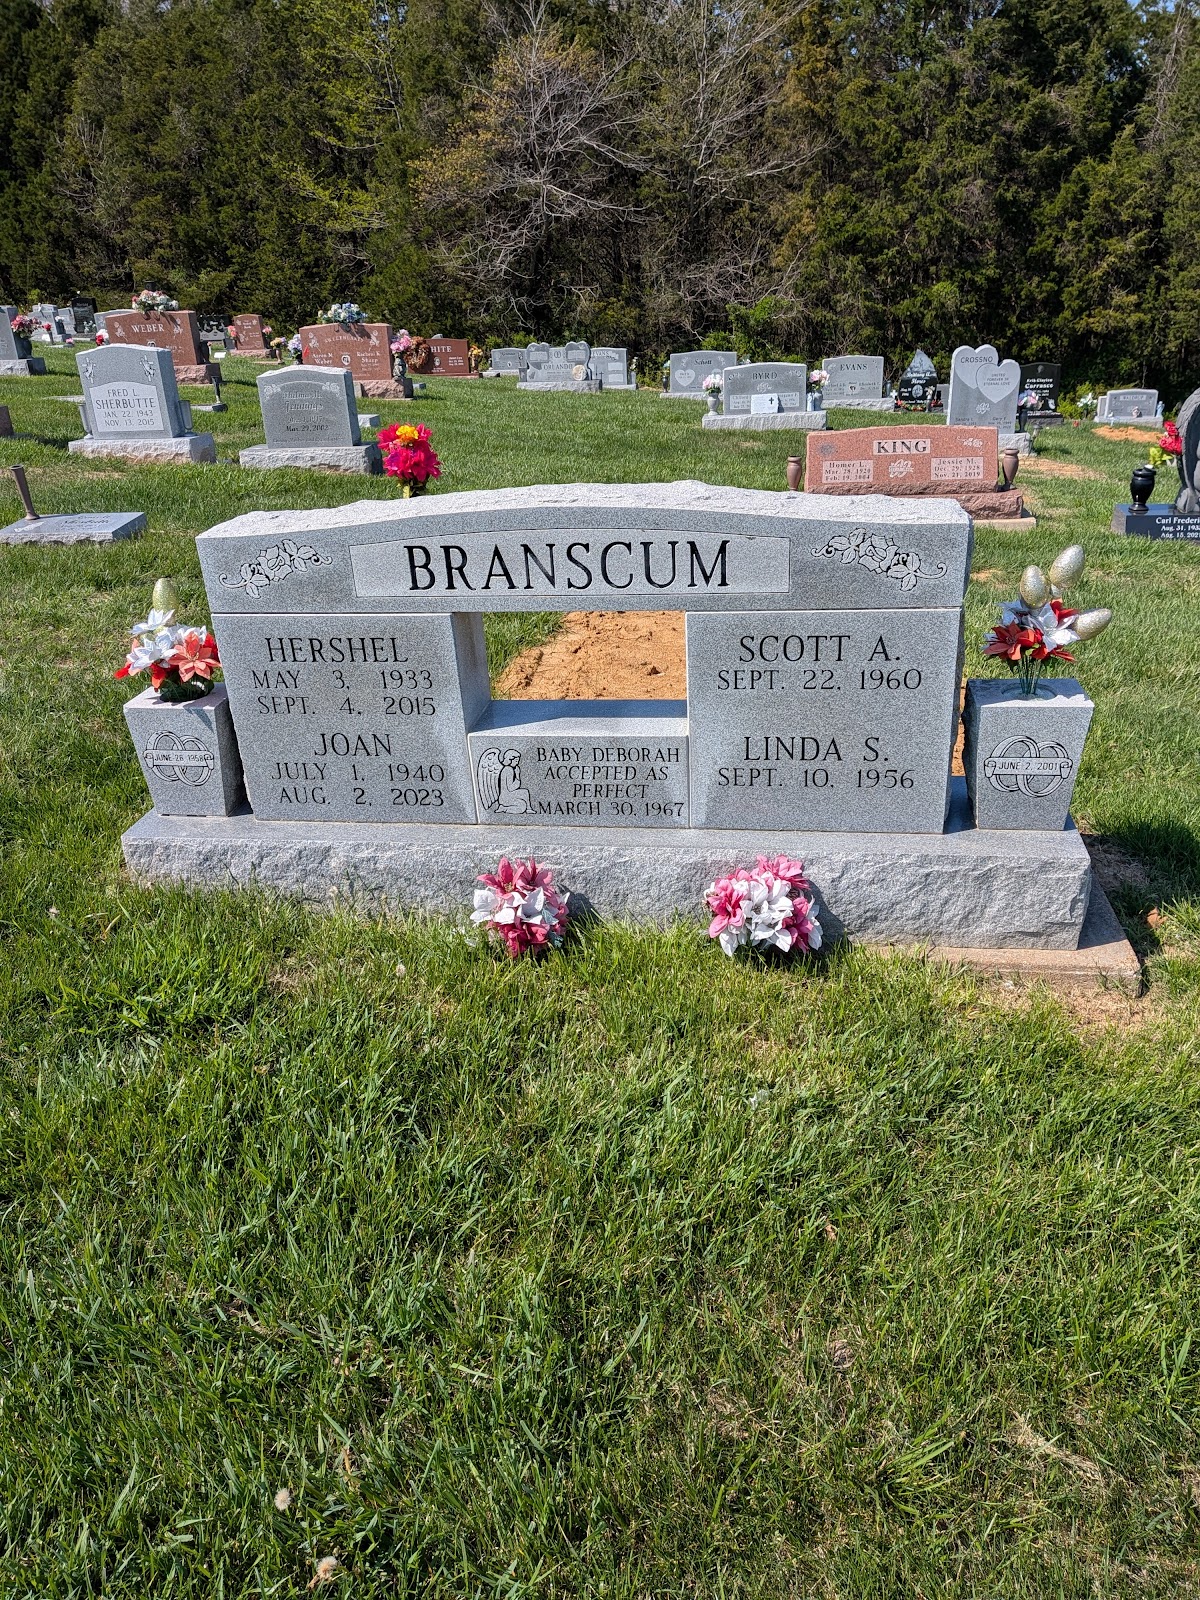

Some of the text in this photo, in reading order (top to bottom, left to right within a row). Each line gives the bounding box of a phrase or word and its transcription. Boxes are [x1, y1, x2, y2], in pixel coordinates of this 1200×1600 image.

[131, 323, 165, 333] WEBER
[430, 345, 452, 353] HITE
[840, 363, 868, 371] EVANS
[960, 356, 994, 364] CROSSNO
[752, 372, 778, 380] BYRD
[107, 388, 129, 397] FRED
[96, 398, 156, 409] SHERBUTTE
[877, 440, 927, 454] KING
[1155, 516, 1171, 524] Carl
[403, 539, 731, 591] BRANSCUM
[264, 637, 409, 663] HERSHEL
[739, 635, 901, 662] SCOTT A.
[251, 669, 433, 690] MAY 3, 1933
[717, 668, 922, 690] SEPT. 22, 1960
[257, 695, 436, 716] SEPT. 4, 2015
[314, 732, 393, 757] JOAN
[743, 736, 889, 762] LINDA S.
[154, 753, 172, 762] JUNE
[537, 747, 680, 763] BABY DEBORAH
[271, 762, 445, 782] JULY 1, 1940
[544, 765, 669, 780] ACCEPTED AS
[998, 761, 1019, 770] JUNE
[1036, 762, 1058, 771] 2001
[718, 767, 915, 789] SEPT. 10, 1956
[279, 786, 444, 807] AUG. 2, 2023
[572, 783, 650, 799] PERFECT
[537, 801, 685, 817] MARCH 30, 1967
